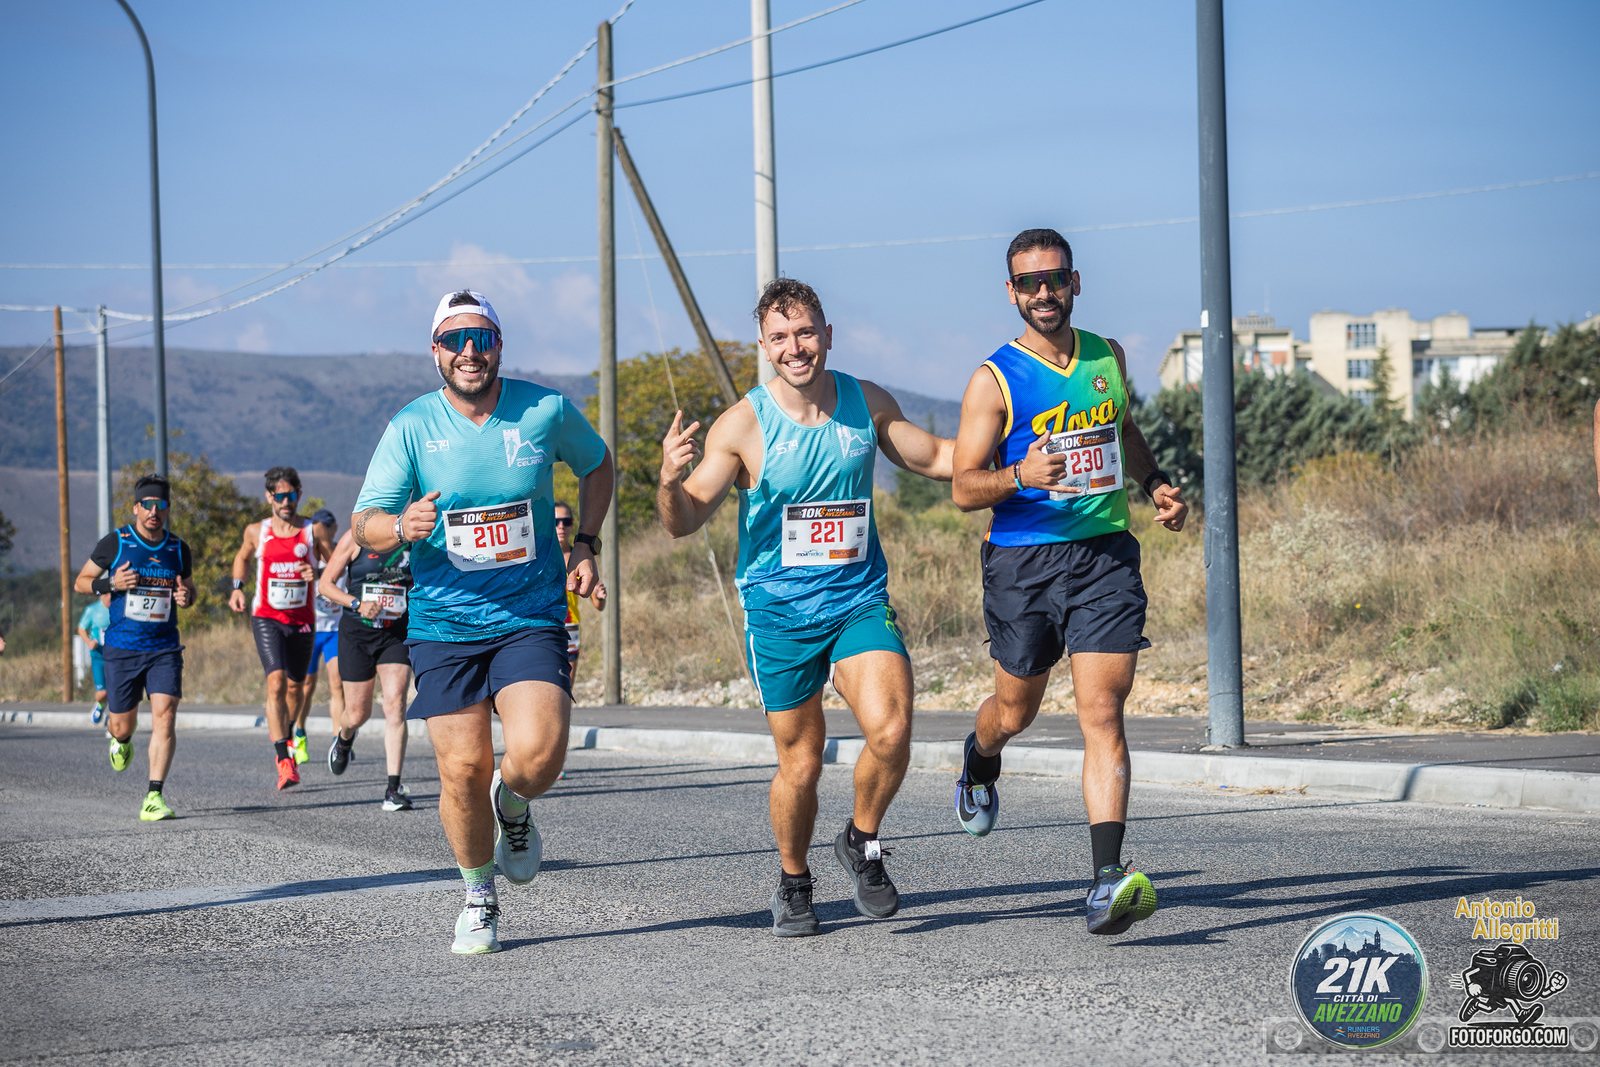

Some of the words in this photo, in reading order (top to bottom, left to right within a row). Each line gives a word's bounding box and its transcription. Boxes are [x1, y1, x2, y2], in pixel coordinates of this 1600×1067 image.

[1060, 436, 1081, 449] 10K
[1070, 447, 1104, 475] 230
[462, 513, 483, 523] 10K
[801, 507, 822, 518] 10K
[473, 523, 508, 548] 210
[811, 521, 843, 543] 221
[284, 589, 294, 598] 71
[143, 598, 157, 609] 27
[378, 596, 394, 607] 182
